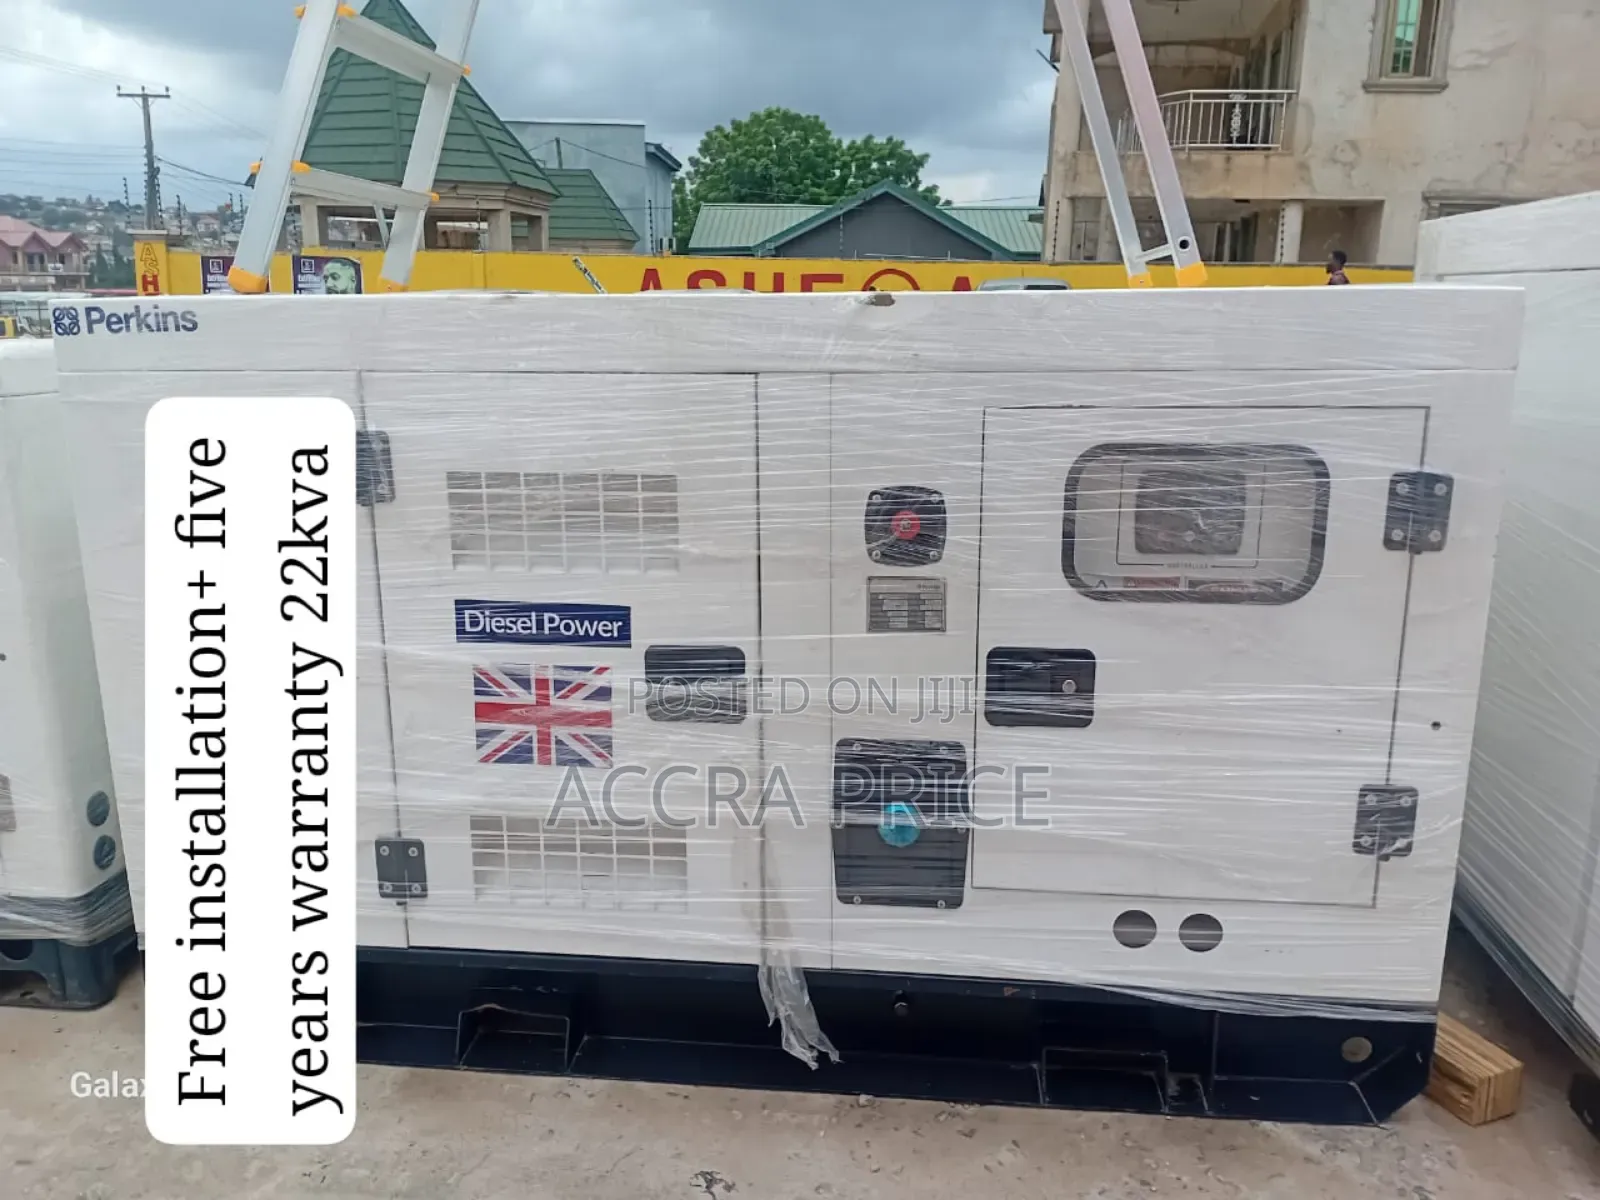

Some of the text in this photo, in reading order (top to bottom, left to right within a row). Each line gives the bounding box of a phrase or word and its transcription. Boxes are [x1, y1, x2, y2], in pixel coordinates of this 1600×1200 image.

[85, 304, 199, 335] Perkins
[464, 609, 623, 638] Diesel Power
